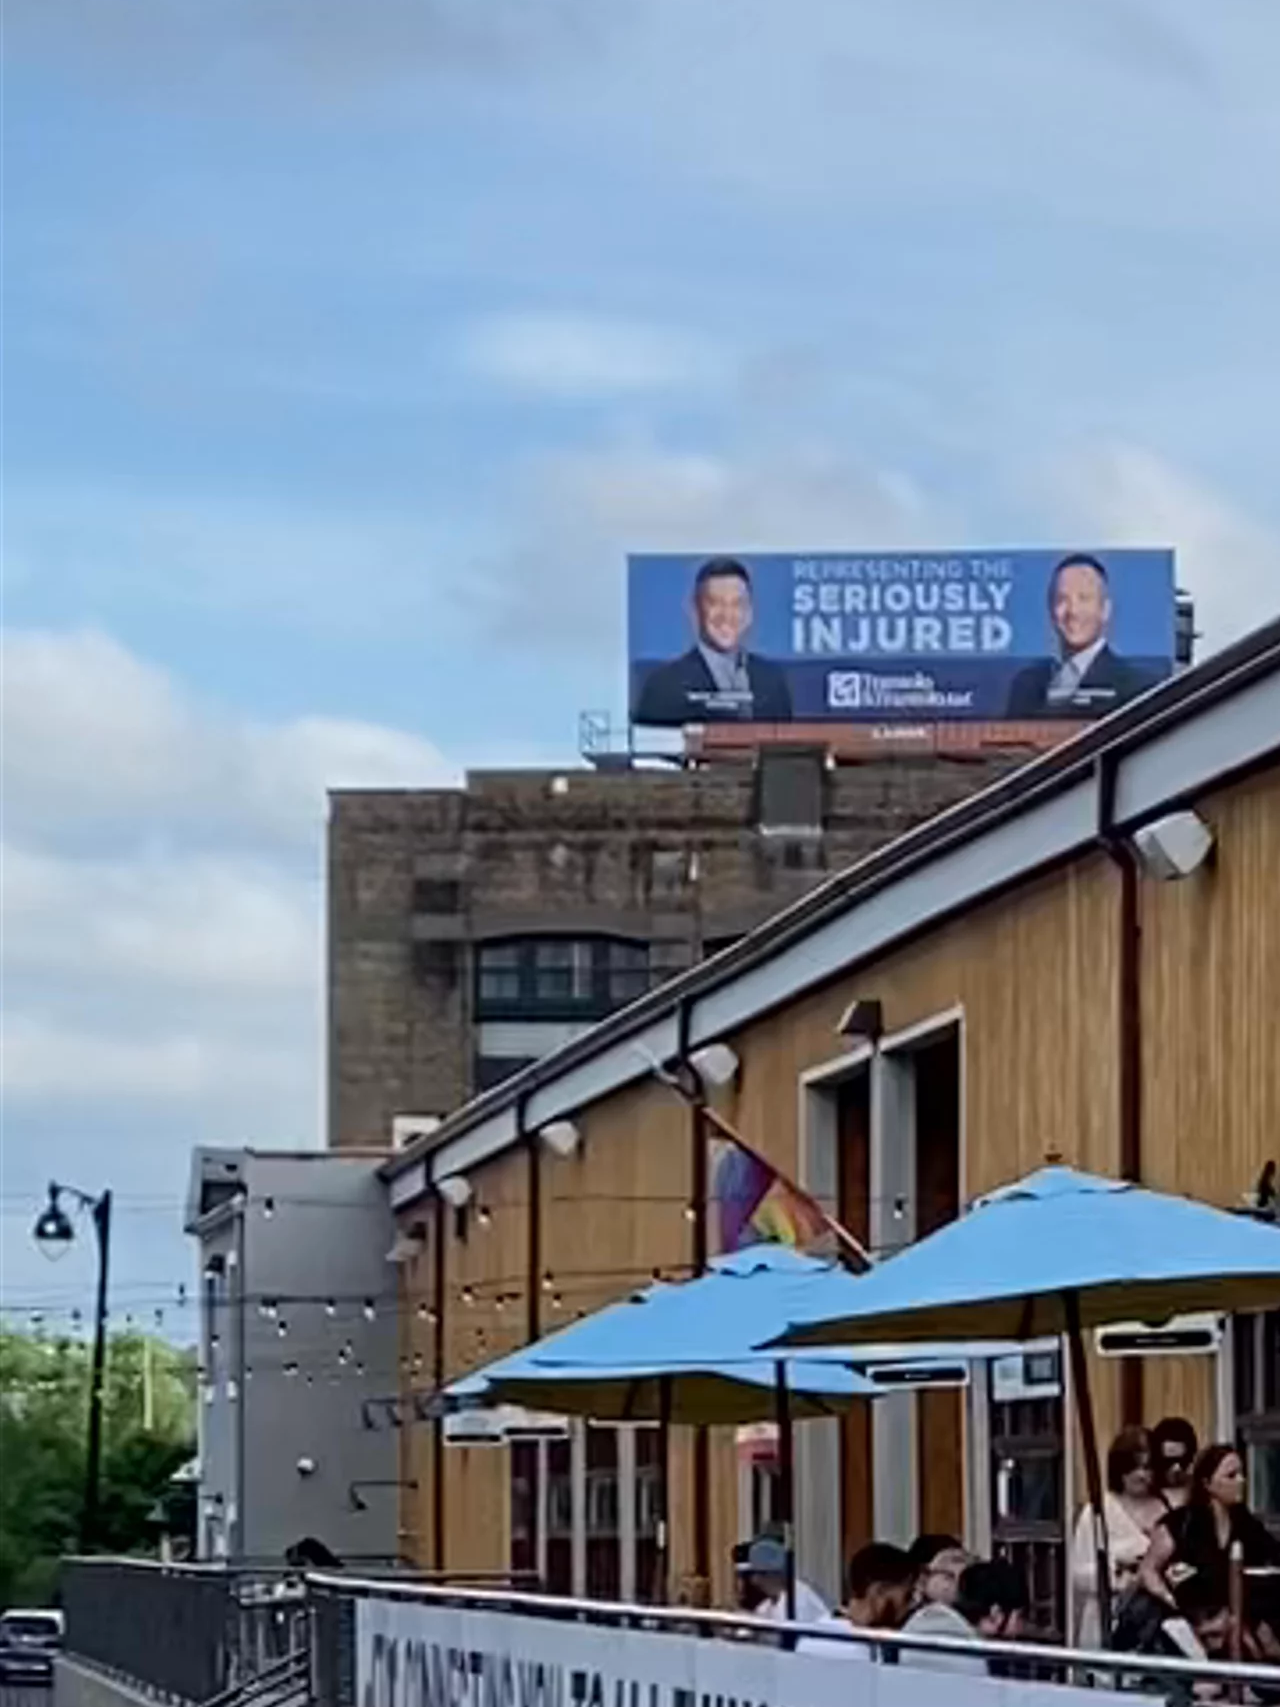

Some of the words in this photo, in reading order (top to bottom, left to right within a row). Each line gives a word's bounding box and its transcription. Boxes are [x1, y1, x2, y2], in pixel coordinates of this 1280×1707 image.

[971, 558, 1013, 578] THE
[793, 582, 1013, 614] SERIOUSLY
[793, 615, 1013, 653] INJURED
